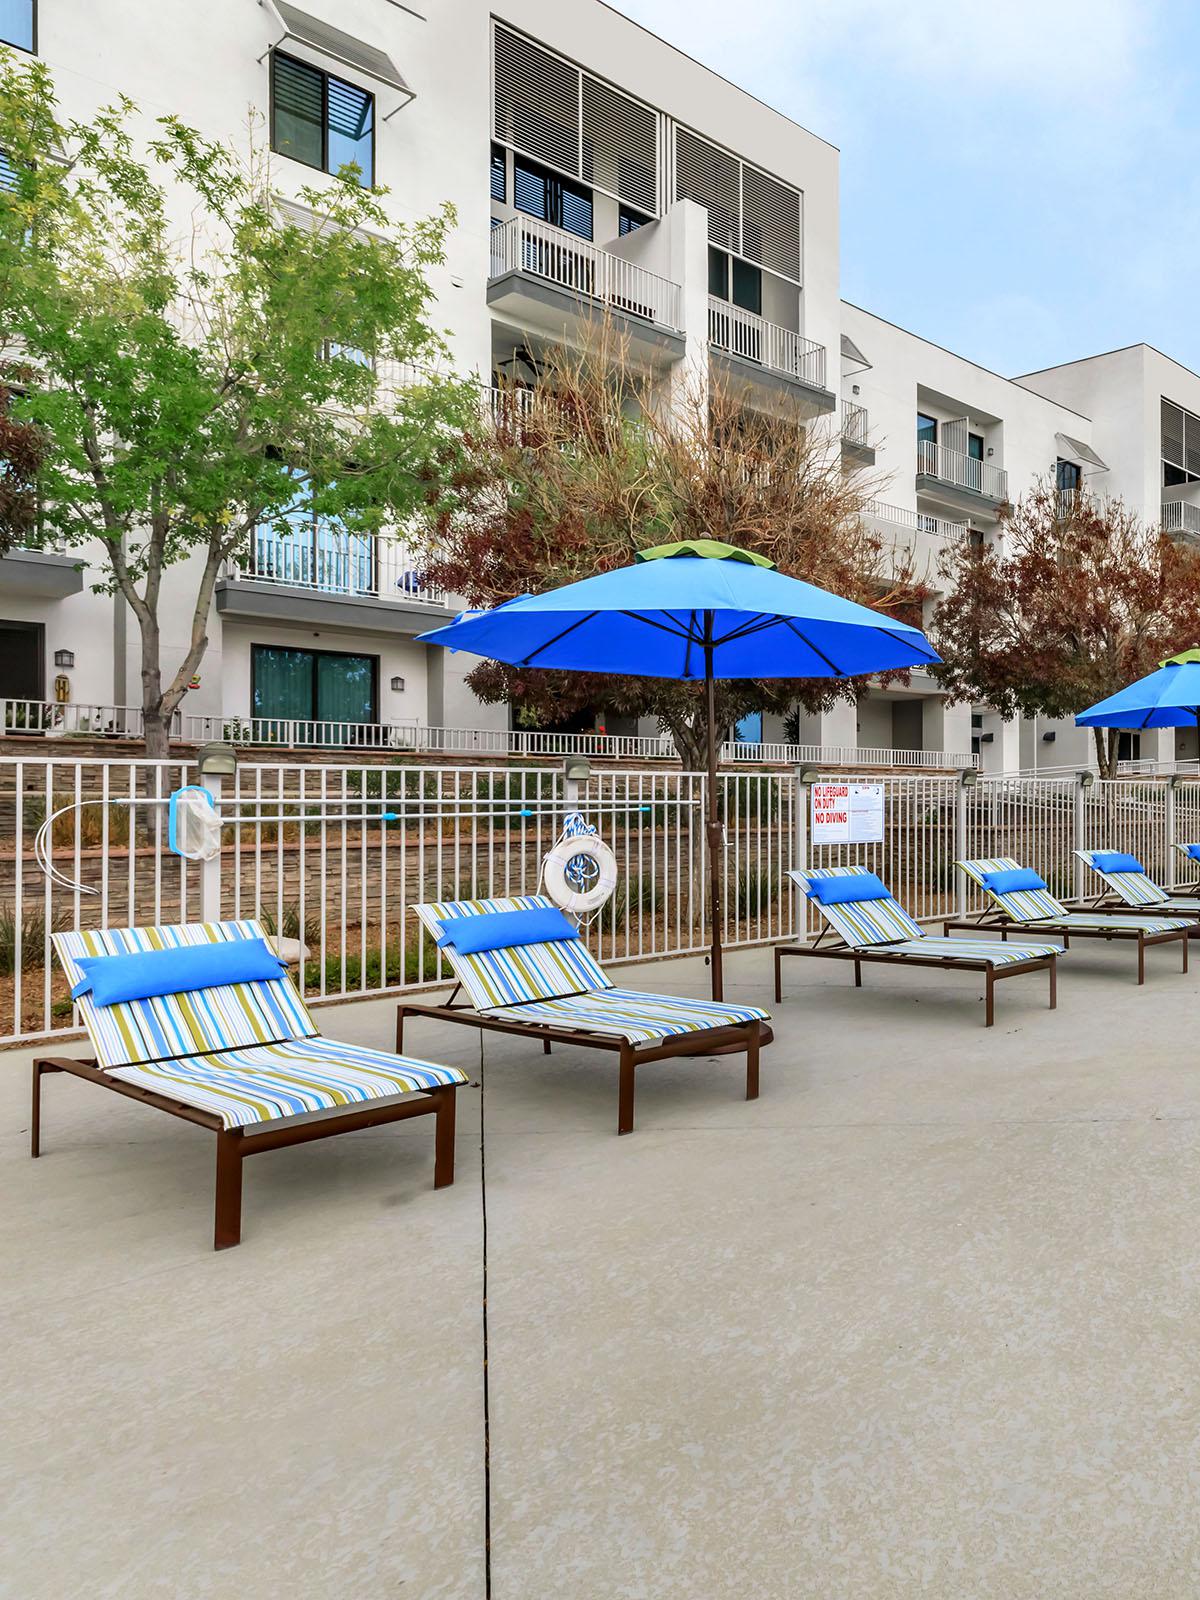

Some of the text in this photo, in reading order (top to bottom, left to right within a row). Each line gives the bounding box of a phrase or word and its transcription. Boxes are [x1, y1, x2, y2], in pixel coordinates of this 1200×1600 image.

[814, 787, 848, 797] NO LIFEGUARD
[815, 799, 835, 809] ON DUTY
[815, 813, 847, 823] NO DIVING
